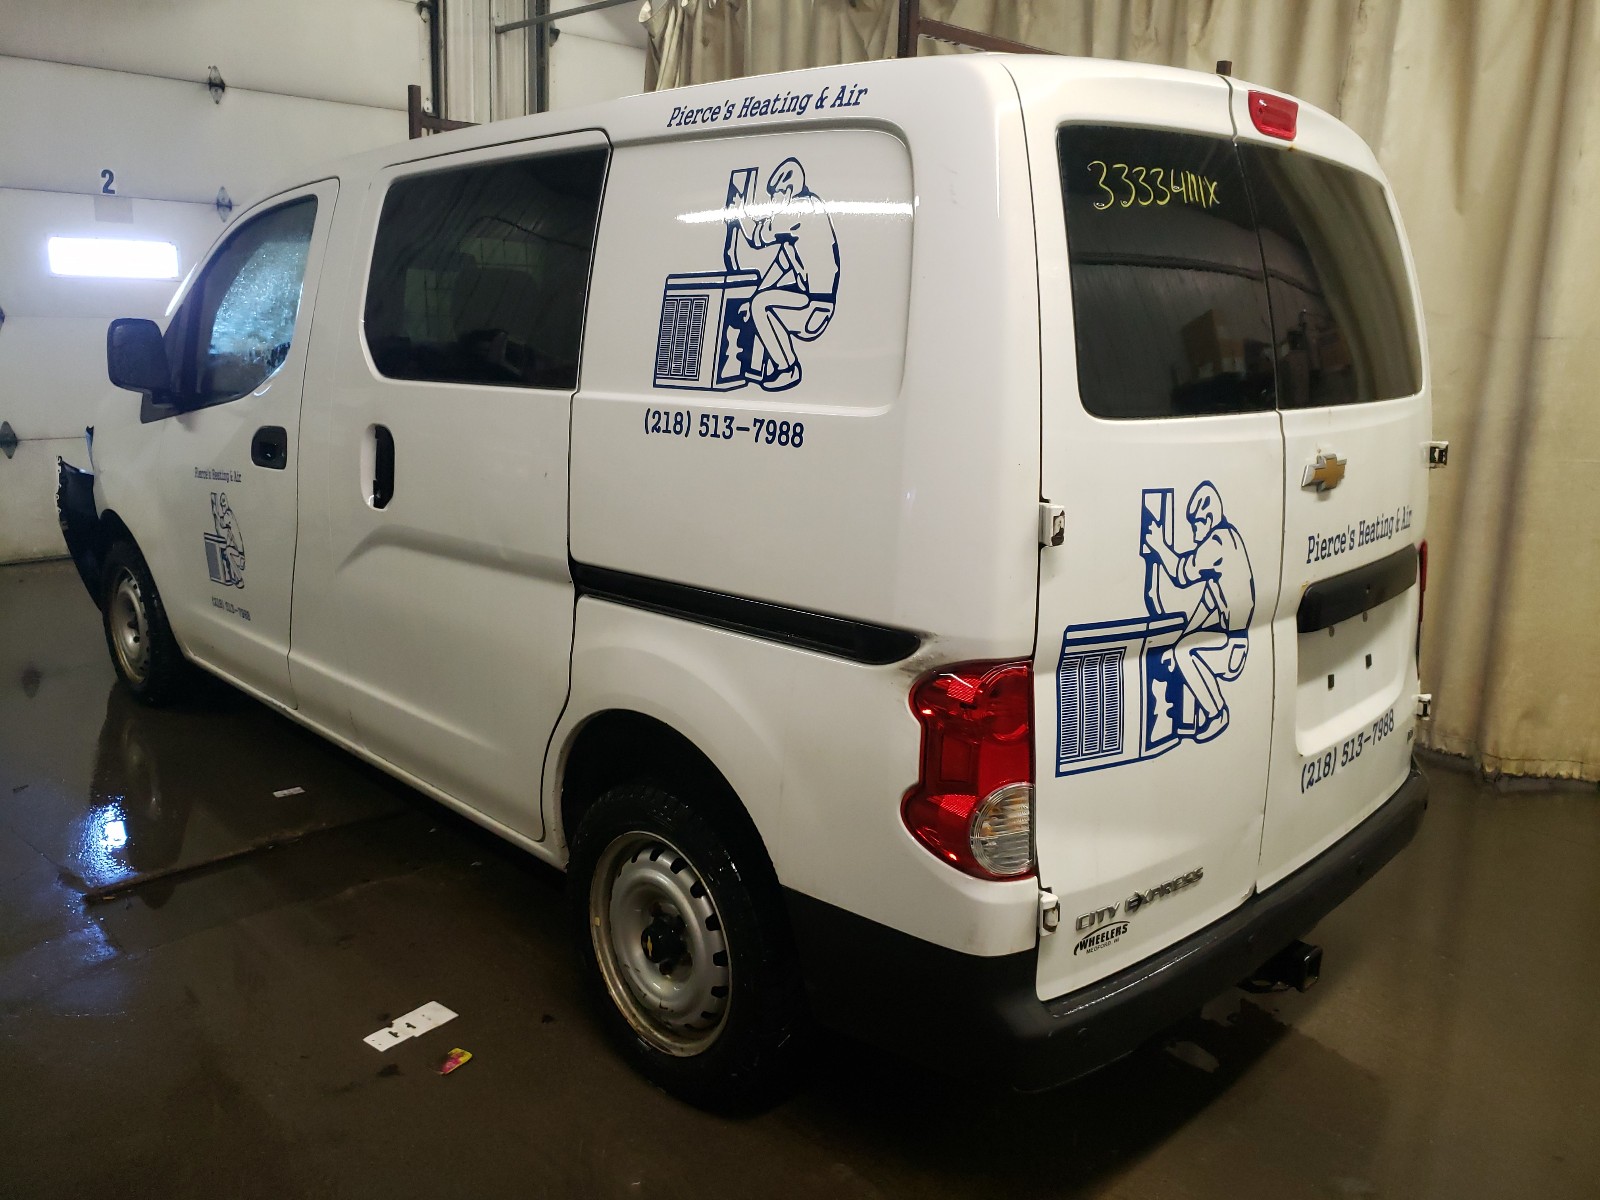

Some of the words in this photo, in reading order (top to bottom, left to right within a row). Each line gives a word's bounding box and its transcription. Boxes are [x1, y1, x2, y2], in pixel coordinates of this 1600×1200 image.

[667, 99, 736, 127] Pierce's
[737, 91, 813, 118] Heating
[814, 86, 829, 110] &
[830, 84, 868, 108] Air
[101, 169, 115, 194] 2
[644, 408, 691, 438] (218)
[698, 413, 804, 448] 513-7988
[1306, 524, 1355, 565] Pierce's
[1358, 513, 1394, 547] Heating
[1401, 505, 1412, 531] Air
[1300, 746, 1337, 794] (218)
[1341, 708, 1394, 767] 513-7988
[1075, 901, 1120, 931] CITY
[1124, 867, 1203, 913] EXPRESS
[1079, 923, 1129, 951] WHEELERS
